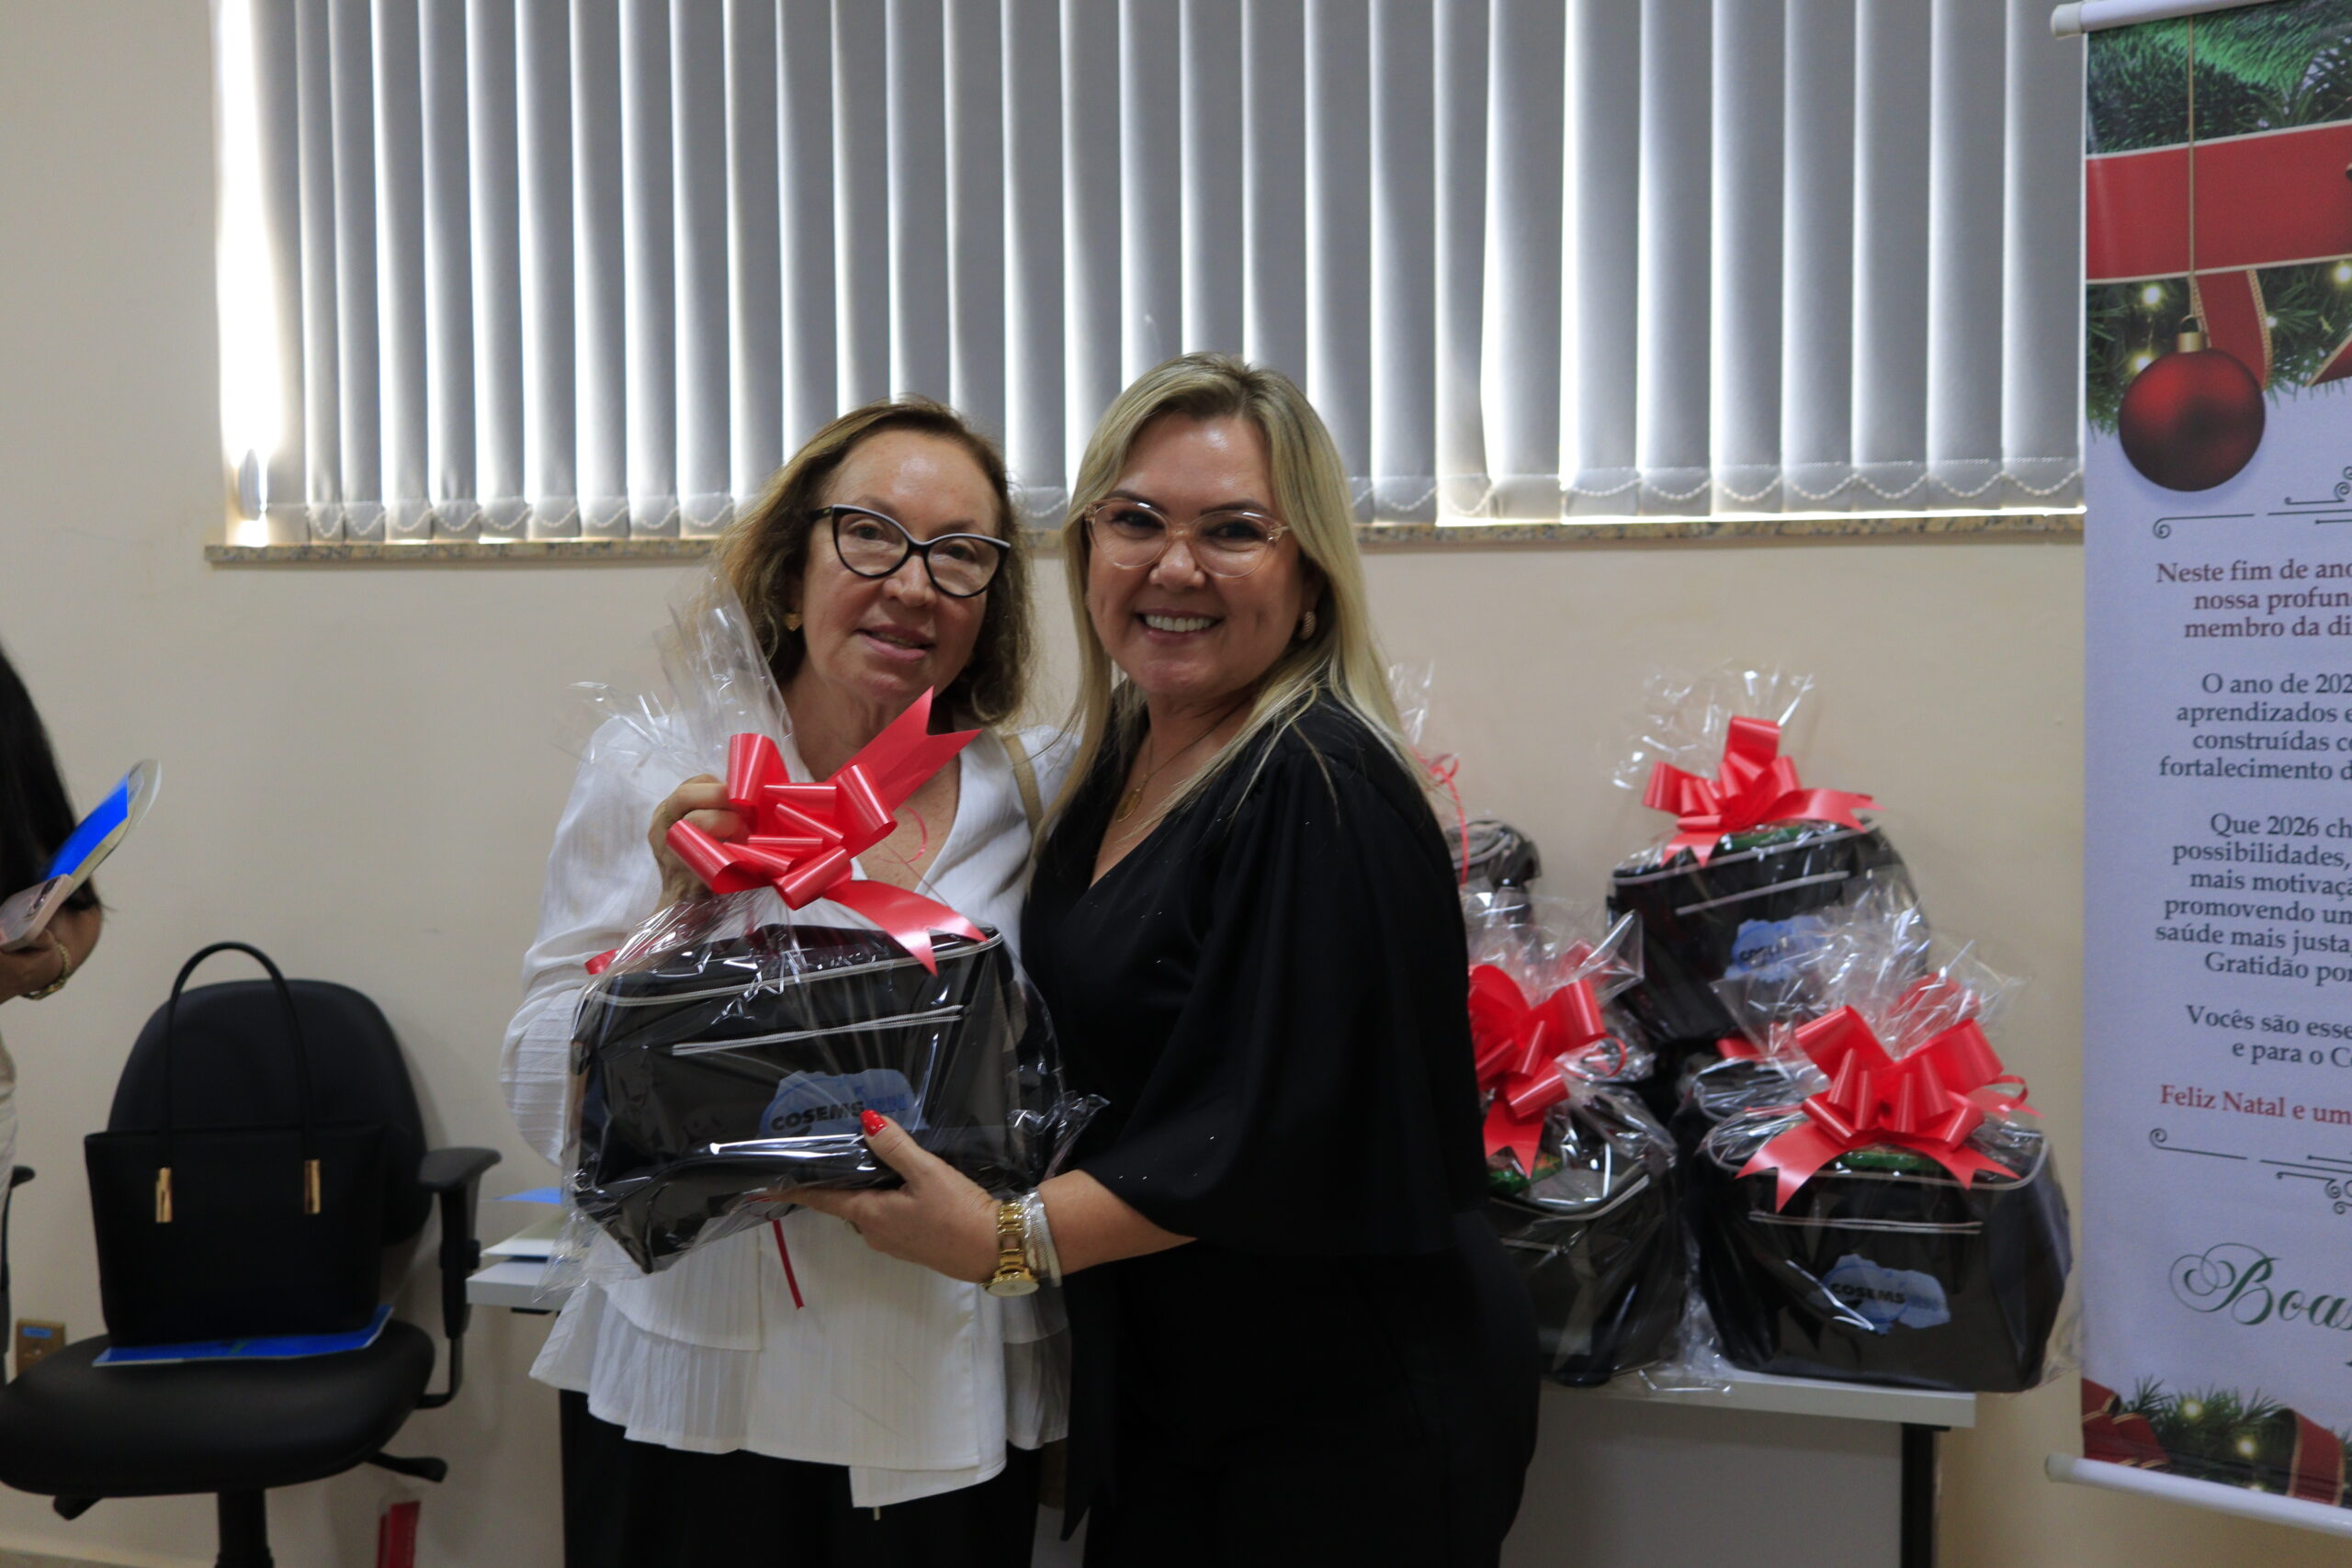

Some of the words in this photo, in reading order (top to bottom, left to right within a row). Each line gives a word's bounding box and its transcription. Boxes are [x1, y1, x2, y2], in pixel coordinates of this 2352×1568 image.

[2156, 562, 2223, 582] Neste
[2231, 560, 2273, 581] fim
[2280, 558, 2307, 579] de
[2194, 595, 2259, 610] nossa
[2267, 587, 2352, 615] profun
[2185, 616, 2284, 637] membro
[2291, 616, 2319, 637] da
[2201, 672, 2222, 694] O
[2230, 678, 2273, 694] ano
[2280, 673, 2309, 694] de
[2315, 674, 2352, 694] 202
[2177, 702, 2337, 728] aprendizados
[2193, 730, 2329, 751] construídas
[2337, 737, 2352, 751] c
[2159, 755, 2332, 780] fortalecimento
[2211, 813, 2260, 838] Que
[2267, 816, 2319, 837] 2026
[2172, 841, 2350, 871] possibilidades,
[2190, 869, 2245, 889] mais
[2165, 899, 2313, 922] promovendo
[2155, 923, 2223, 943] saúde
[2231, 928, 2286, 948] mais
[2205, 952, 2308, 978] Gratidão
[2187, 1005, 2255, 1030] Vocês
[2261, 1015, 2299, 1034] são
[2306, 1021, 2352, 1040] esse
[2233, 1043, 2244, 1056] e
[2251, 1043, 2301, 1066] para
[2310, 1051, 2323, 1065] o
[2332, 1046, 2352, 1067] C
[2161, 1085, 2216, 1109] Feliz
[2222, 1091, 2286, 1117] Natal
[2293, 1105, 2304, 1119] e
[771, 1100, 865, 1132] COSEMS
